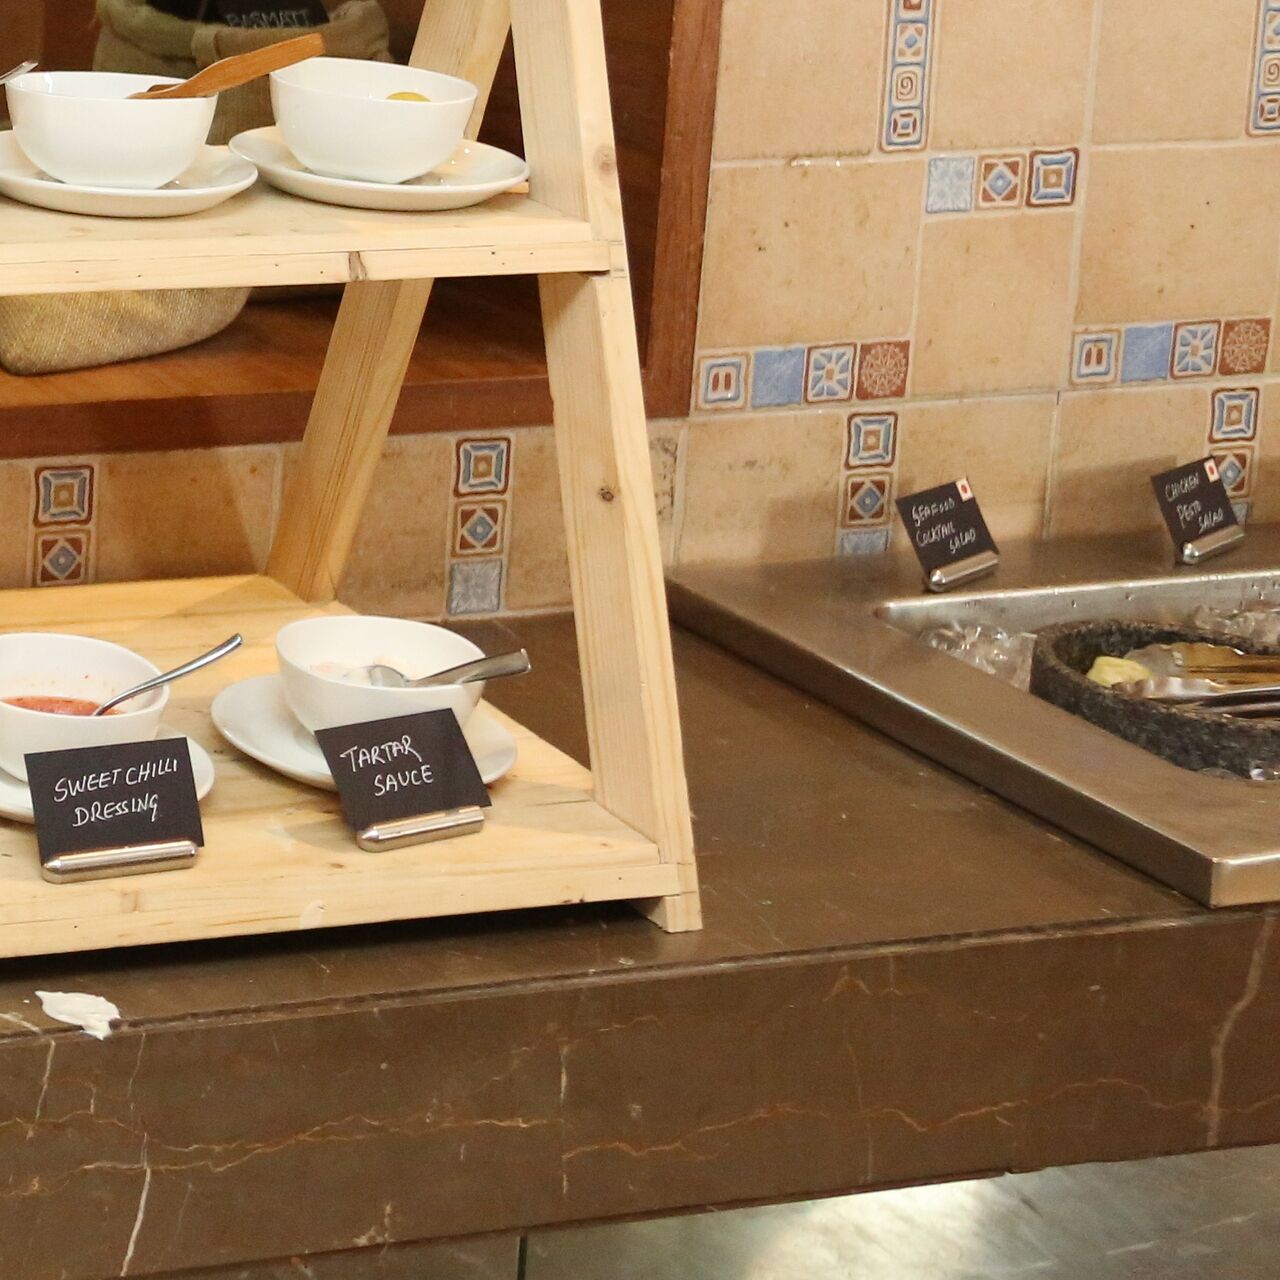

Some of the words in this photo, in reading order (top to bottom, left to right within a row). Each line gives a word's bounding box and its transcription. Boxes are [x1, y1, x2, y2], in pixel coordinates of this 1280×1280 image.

[949, 527, 977, 555] SALAD
[339, 734, 423, 773] TARTAR
[53, 768, 122, 803] SWEET
[125, 757, 178, 786] CHILLI
[374, 764, 435, 797] SAUCE
[72, 792, 159, 828] DRESSING
